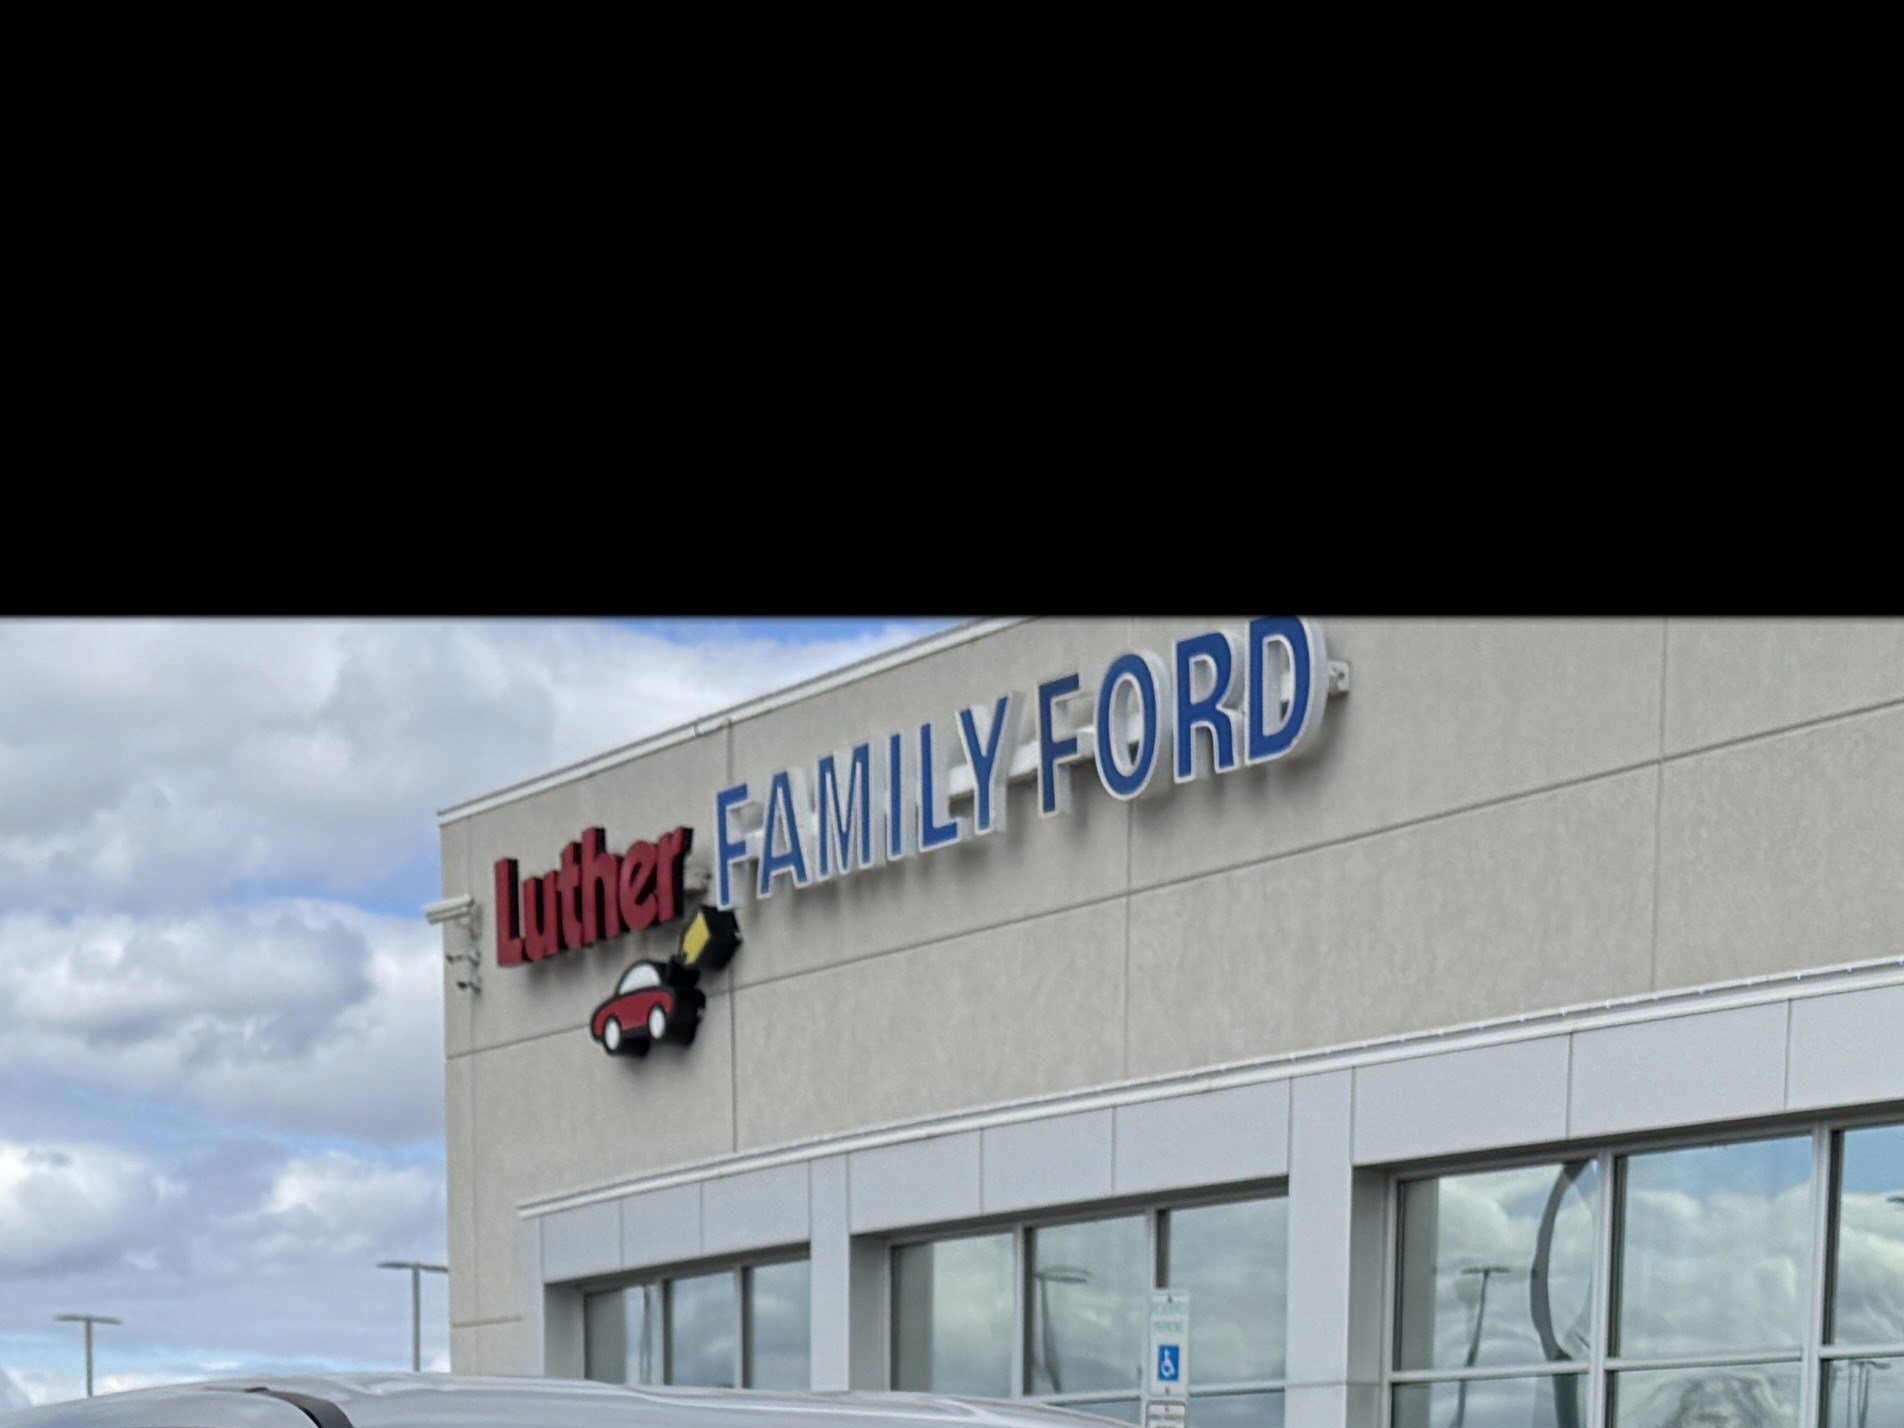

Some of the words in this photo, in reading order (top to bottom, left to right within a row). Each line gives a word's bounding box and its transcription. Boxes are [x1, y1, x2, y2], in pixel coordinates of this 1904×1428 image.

[714, 692, 1017, 911] FAMILY
[1037, 616, 1324, 816] FORD
[494, 826, 694, 967] Luther
